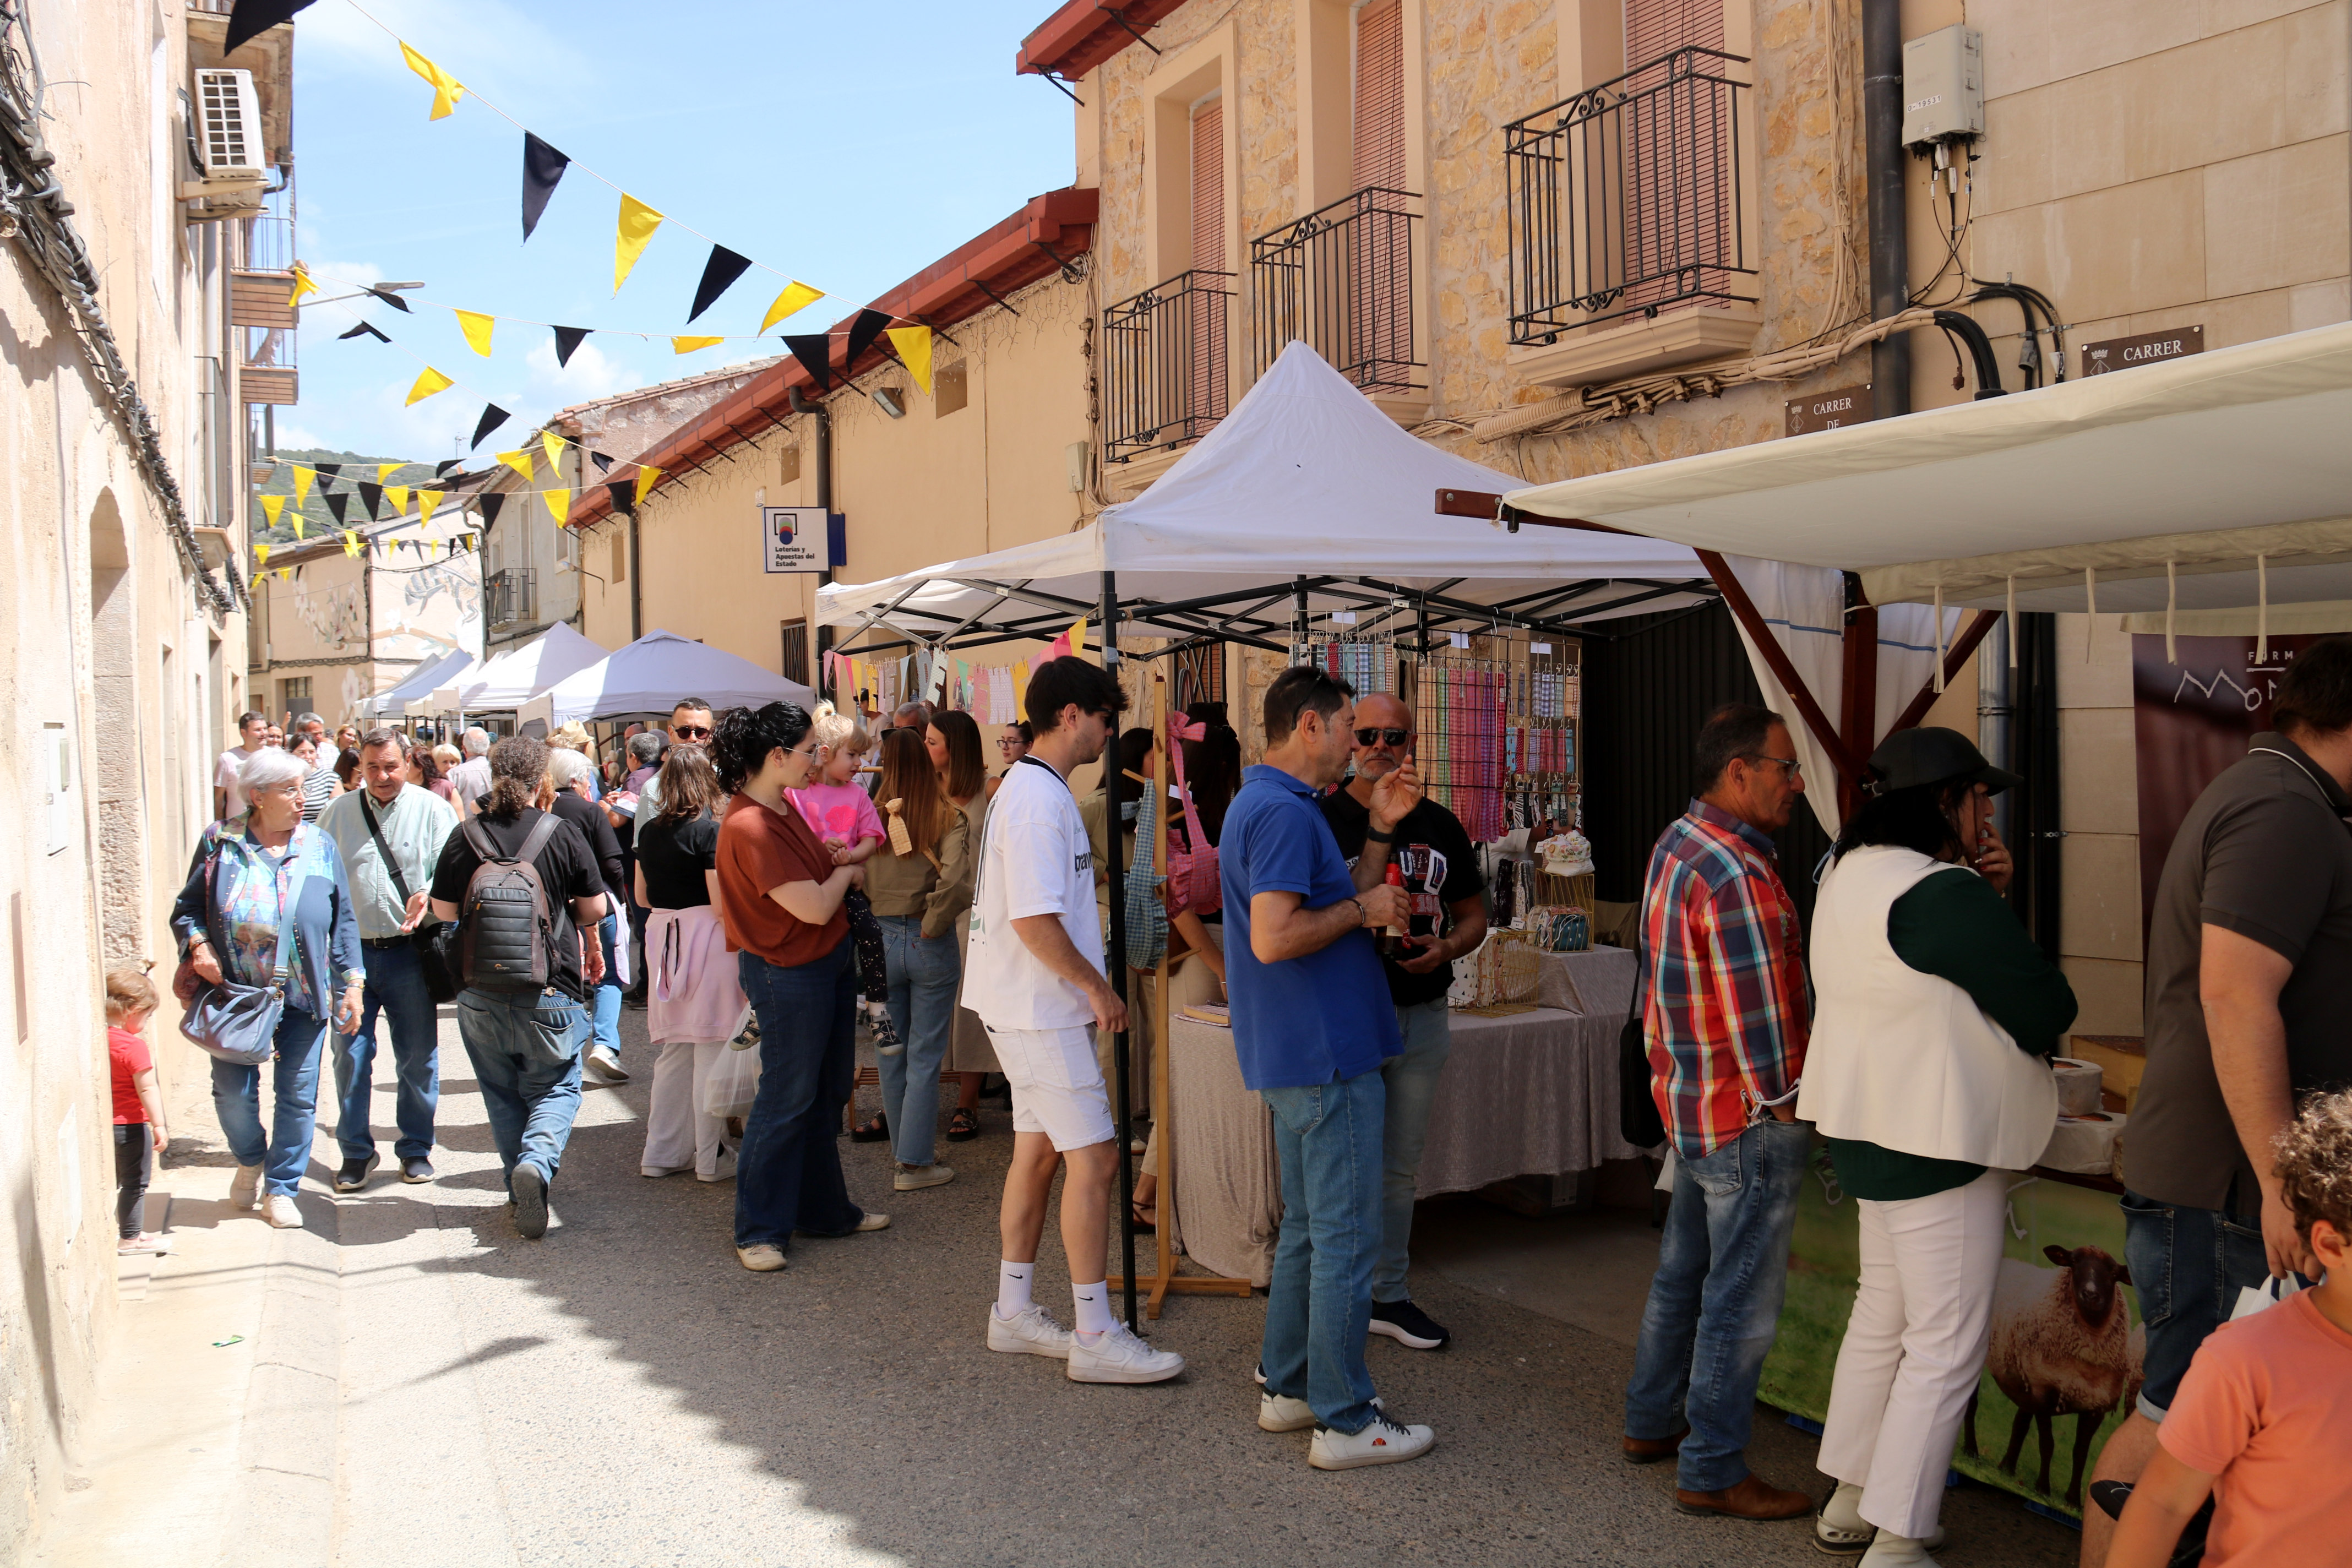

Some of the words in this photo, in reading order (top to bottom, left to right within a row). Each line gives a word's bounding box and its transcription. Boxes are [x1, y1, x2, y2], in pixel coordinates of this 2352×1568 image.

[2124, 340, 2182, 361] CARRER
[1813, 397, 1852, 415] CARRER
[2248, 651, 2293, 660] FRM
